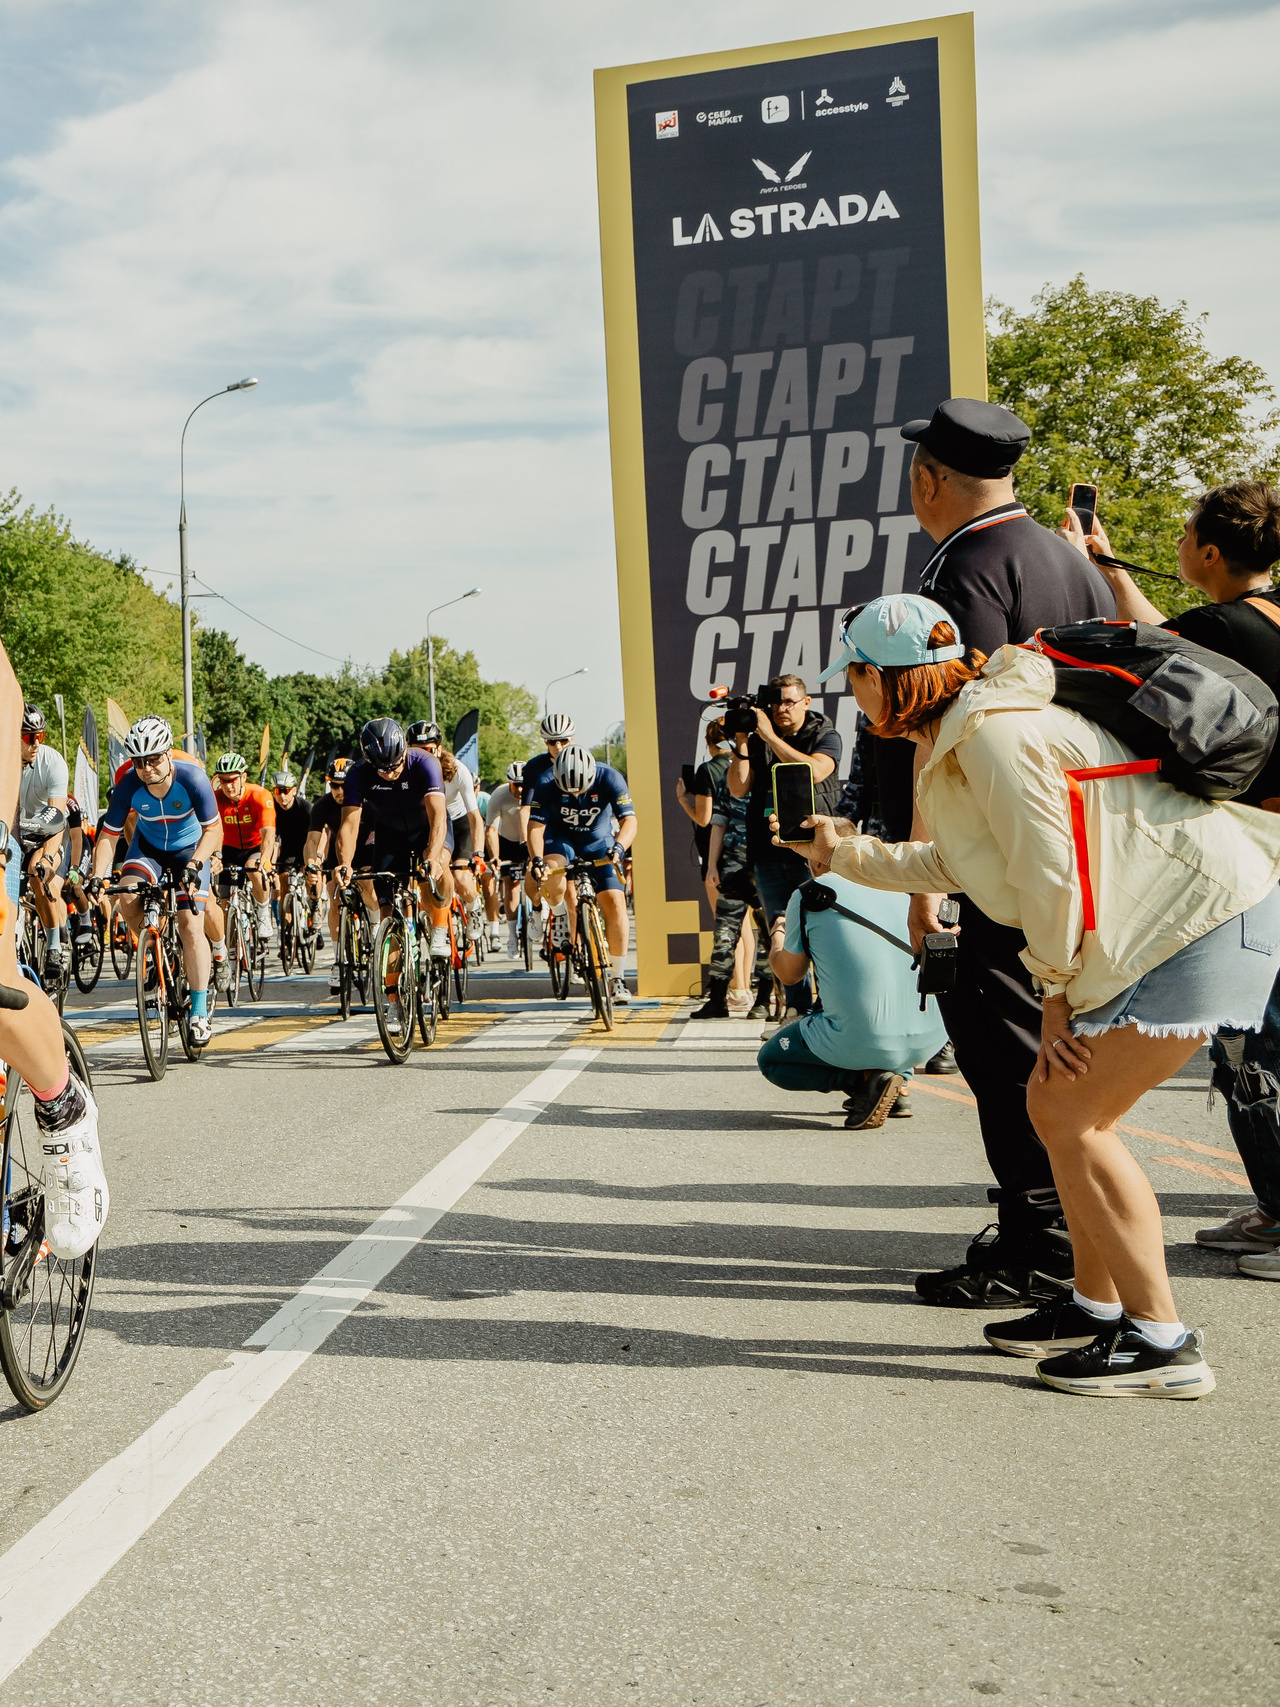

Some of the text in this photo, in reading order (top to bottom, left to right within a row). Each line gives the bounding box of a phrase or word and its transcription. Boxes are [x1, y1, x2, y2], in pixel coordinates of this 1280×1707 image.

[708, 110, 731, 120] СБЕР
[708, 115, 743, 127] МАРКЕТ
[815, 102, 869, 117] accesstyle
[672, 190, 900, 247] LA STRADA
[673, 247, 911, 357] СТАРТ
[677, 335, 915, 443] СТАРТ
[681, 426, 918, 529] СТАРТ
[685, 514, 921, 615] СТАРТ
[42, 1143, 70, 1155] SIDI
[94, 1187, 103, 1224] SIDI
